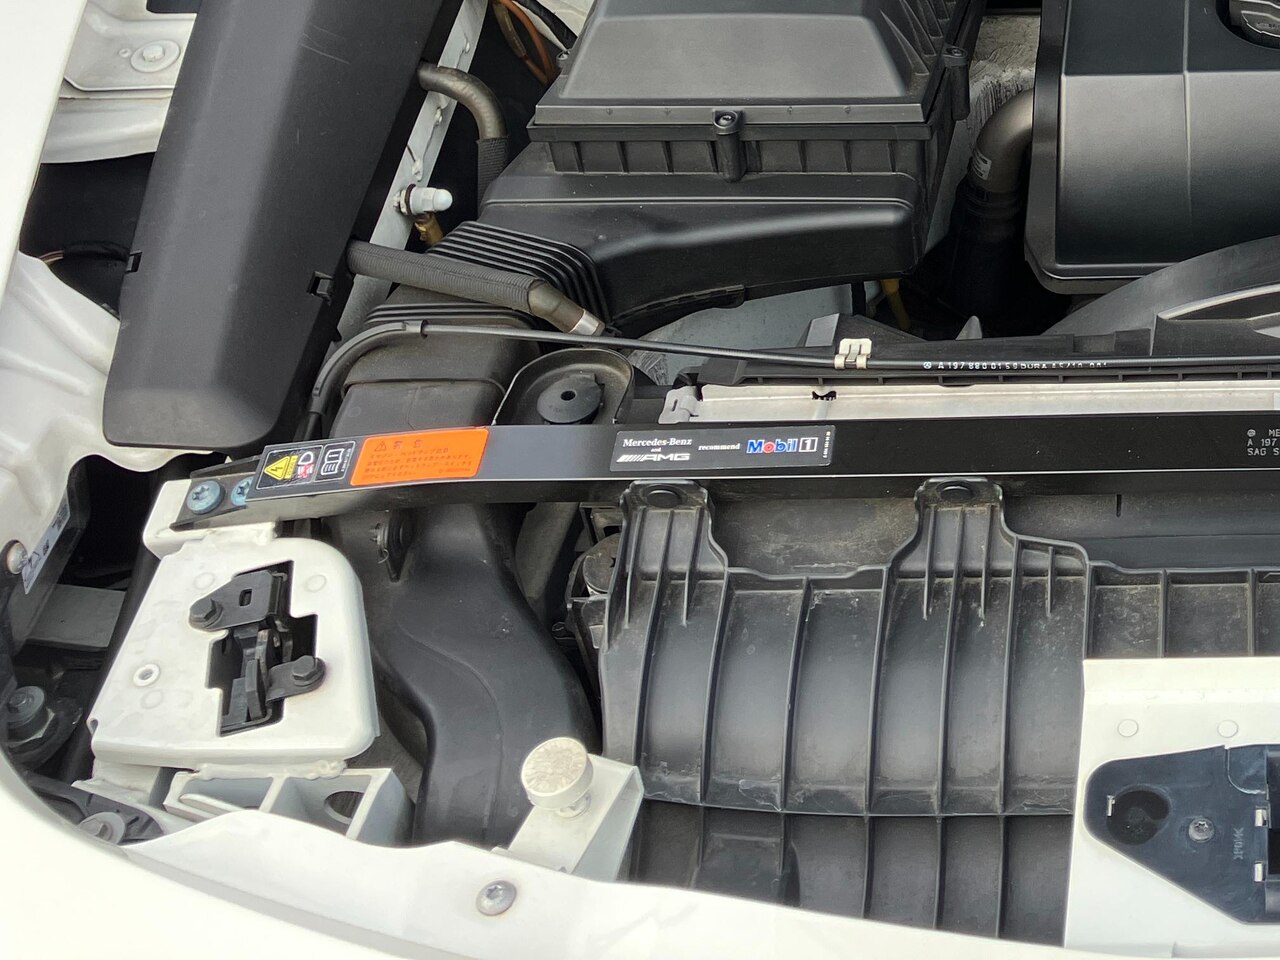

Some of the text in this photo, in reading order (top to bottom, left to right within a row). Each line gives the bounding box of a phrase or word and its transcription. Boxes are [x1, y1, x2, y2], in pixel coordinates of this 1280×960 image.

[622, 437, 693, 447] Mercedes-Benz
[698, 443, 741, 451] recommend
[746, 438, 798, 453] Mobil
[1246, 438, 1254, 447] A
[1261, 438, 1278, 447] 197
[1247, 447, 1267, 456] SAG
[640, 453, 691, 462] AMG
